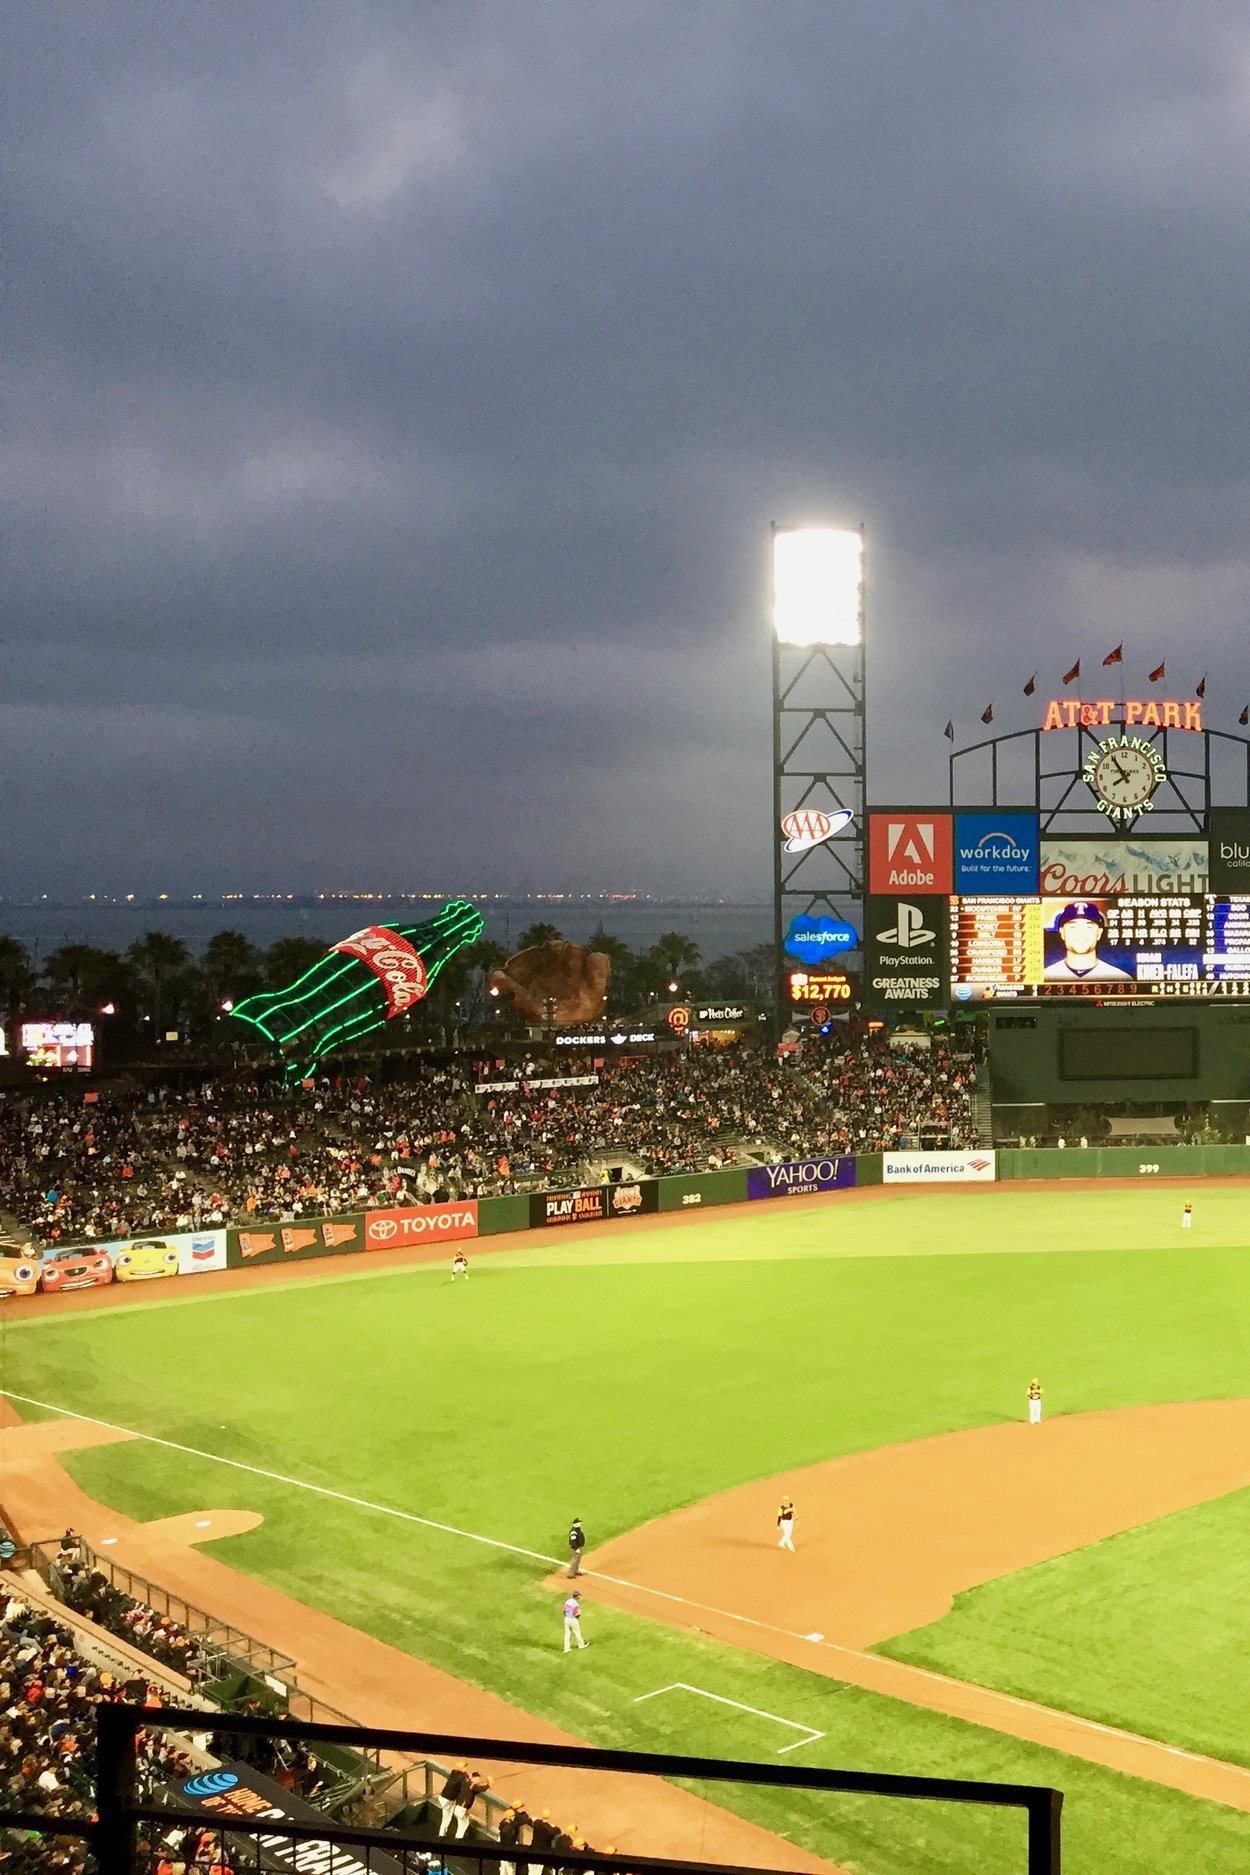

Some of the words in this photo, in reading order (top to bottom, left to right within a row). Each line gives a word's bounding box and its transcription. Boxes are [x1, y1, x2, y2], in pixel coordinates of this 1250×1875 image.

[1042, 701, 1115, 731] AT&T
[1126, 702, 1203, 732] PARK
[1082, 751, 1101, 783] SAN
[1099, 735, 1167, 783] FRANCISCO
[1097, 799, 1154, 819] GIANTS
[785, 813, 829, 840] AAA
[960, 845, 1029, 861] workday
[889, 870, 934, 885] Adobe
[1040, 863, 1129, 893] Coors
[1133, 874, 1209, 893] LIGHT
[1118, 898, 1158, 907] SEASON
[1160, 898, 1190, 907] STATS
[794, 931, 849, 944] salesforce
[879, 956, 934, 967] PlayStation
[872, 978, 940, 988] GREATNESS
[1044, 986, 1052, 995] 2
[1057, 985, 1064, 995] 3
[1069, 985, 1076, 994] 4
[1082, 985, 1089, 994] 5
[1094, 985, 1101, 994] 6
[1107, 985, 1113, 994] 7
[1117, 985, 1124, 994] 8
[1130, 984, 1137, 994] 9
[791, 984, 850, 1000] $12,770
[884, 988, 929, 999] AWAITS
[556, 1035, 606, 1045] DOCKERS
[629, 1033, 655, 1043] DECK
[765, 1160, 838, 1187] YAHOO!
[887, 1164, 912, 1174] Bank
[912, 1164, 923, 1174] of
[924, 1164, 965, 1174] America
[1139, 1164, 1159, 1174] 399
[787, 1183, 818, 1195] SPORTS
[547, 1200, 574, 1216] PLAY
[575, 1197, 602, 1213] BALL
[683, 1194, 701, 1205] 382
[400, 1211, 475, 1234] TOYOTA
